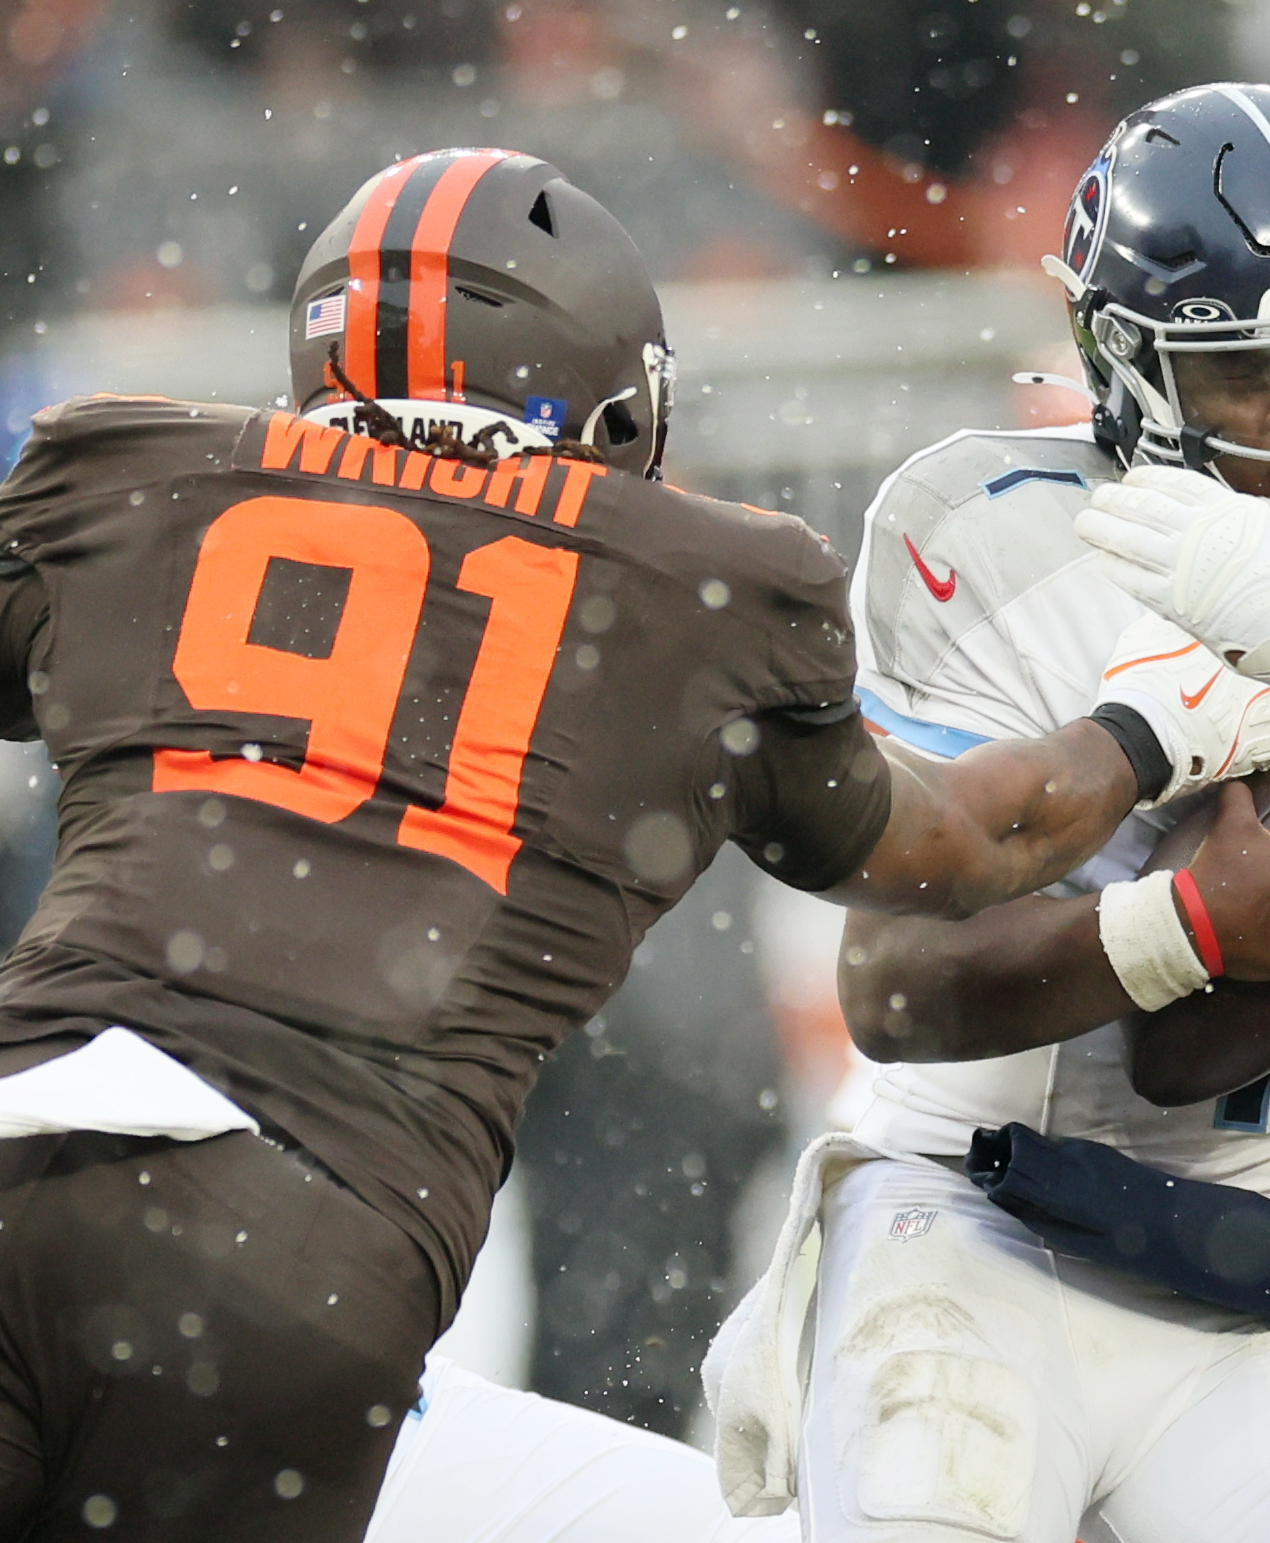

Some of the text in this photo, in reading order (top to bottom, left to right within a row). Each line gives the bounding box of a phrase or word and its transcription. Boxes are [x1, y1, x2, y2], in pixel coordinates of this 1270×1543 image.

[261, 411, 609, 529] WRIGHT
[152, 495, 580, 896] 91
[893, 1219, 923, 1235] NFL
